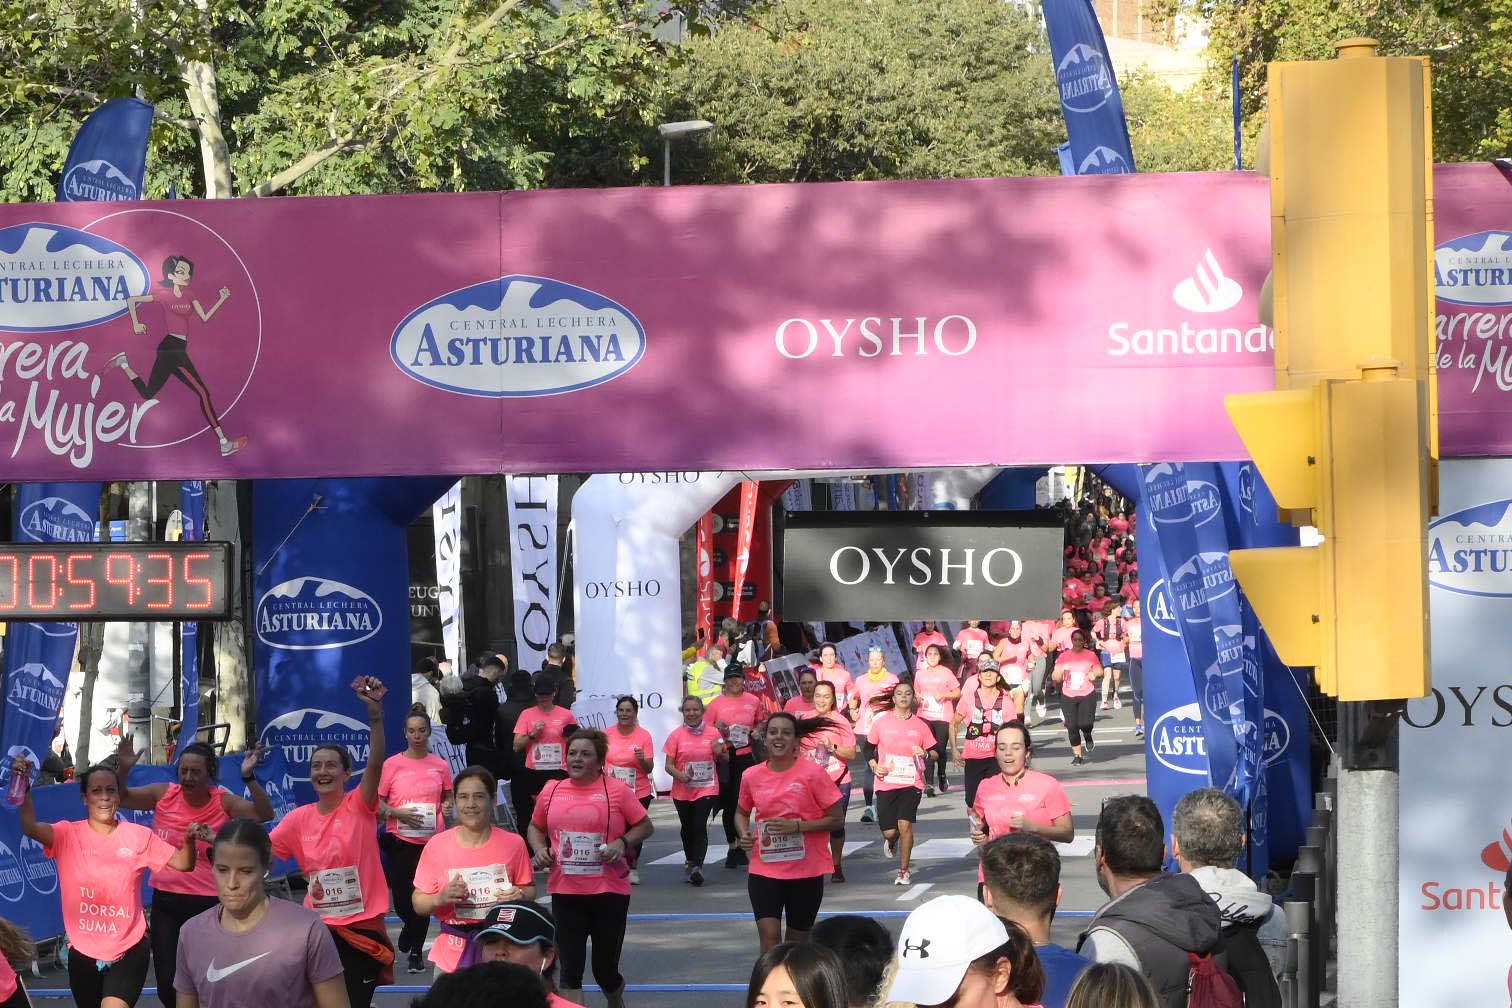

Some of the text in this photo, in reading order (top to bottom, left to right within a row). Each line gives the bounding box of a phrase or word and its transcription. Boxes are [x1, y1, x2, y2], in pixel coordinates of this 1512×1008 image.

[53, 258, 125, 270] LECHERA
[449, 315, 617, 331] CENTRAL LECHERA
[1436, 312, 1512, 341] arrer
[410, 322, 626, 368] ASTURIANA
[775, 314, 977, 359] OYSHO
[1108, 320, 1275, 356] Santand
[1458, 341, 1476, 368] la
[11, 374, 160, 469] Mujer
[1429, 537, 1512, 573] ASTU
[829, 546, 1023, 587] OYSHO
[585, 580, 661, 599] OYSHO
[273, 601, 369, 611] CENTRAL LECHERA
[260, 606, 374, 633] ASTURIANA
[1174, 725, 1202, 733] CENT
[573, 848, 590, 856] 016
[80, 886, 94, 899] TU
[326, 887, 343, 896] 016
[470, 887, 491, 896] 016
[1421, 881, 1501, 910] Sant
[80, 902, 131, 918] DORSAL
[79, 918, 118, 934] SUMA
